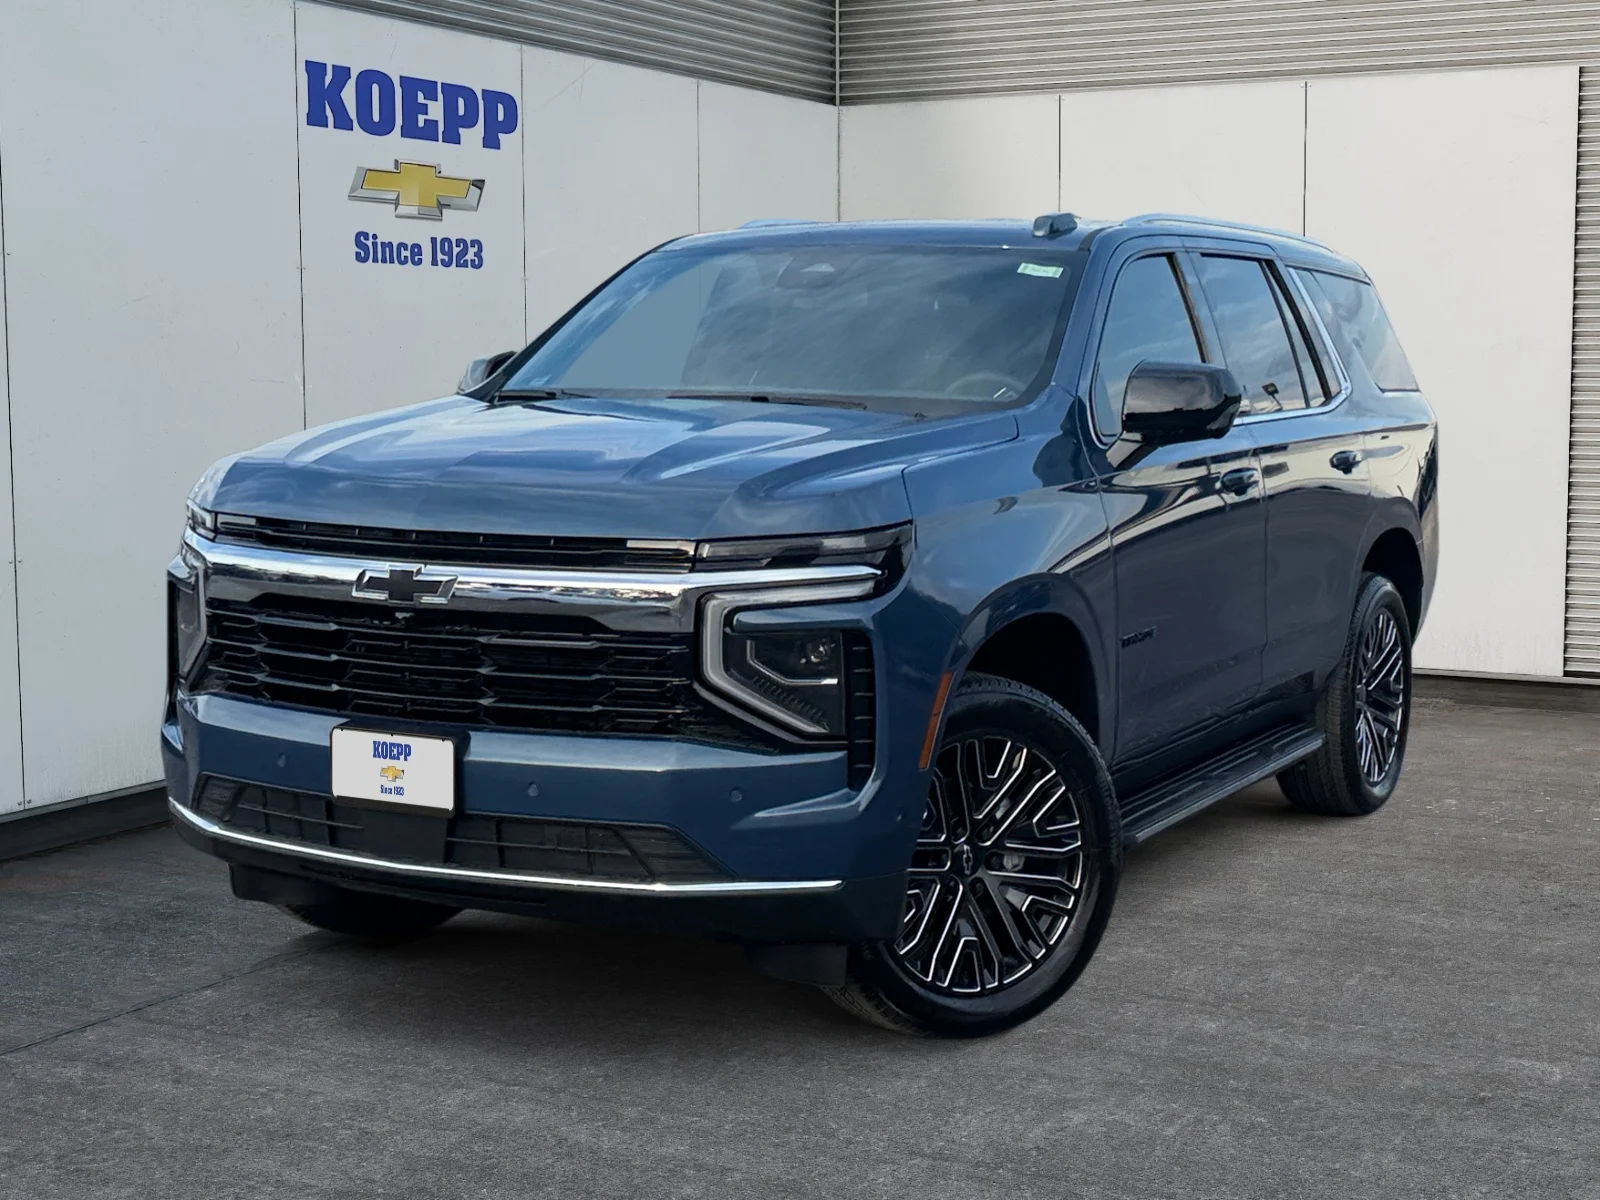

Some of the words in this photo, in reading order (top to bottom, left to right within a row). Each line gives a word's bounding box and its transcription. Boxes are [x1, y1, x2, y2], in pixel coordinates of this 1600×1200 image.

[305, 60, 518, 150] KOEPP
[354, 231, 423, 266] Since
[430, 237, 484, 270] 1923
[372, 740, 412, 761] KOEPP
[380, 784, 393, 795] Since
[393, 785, 405, 796] 1923
